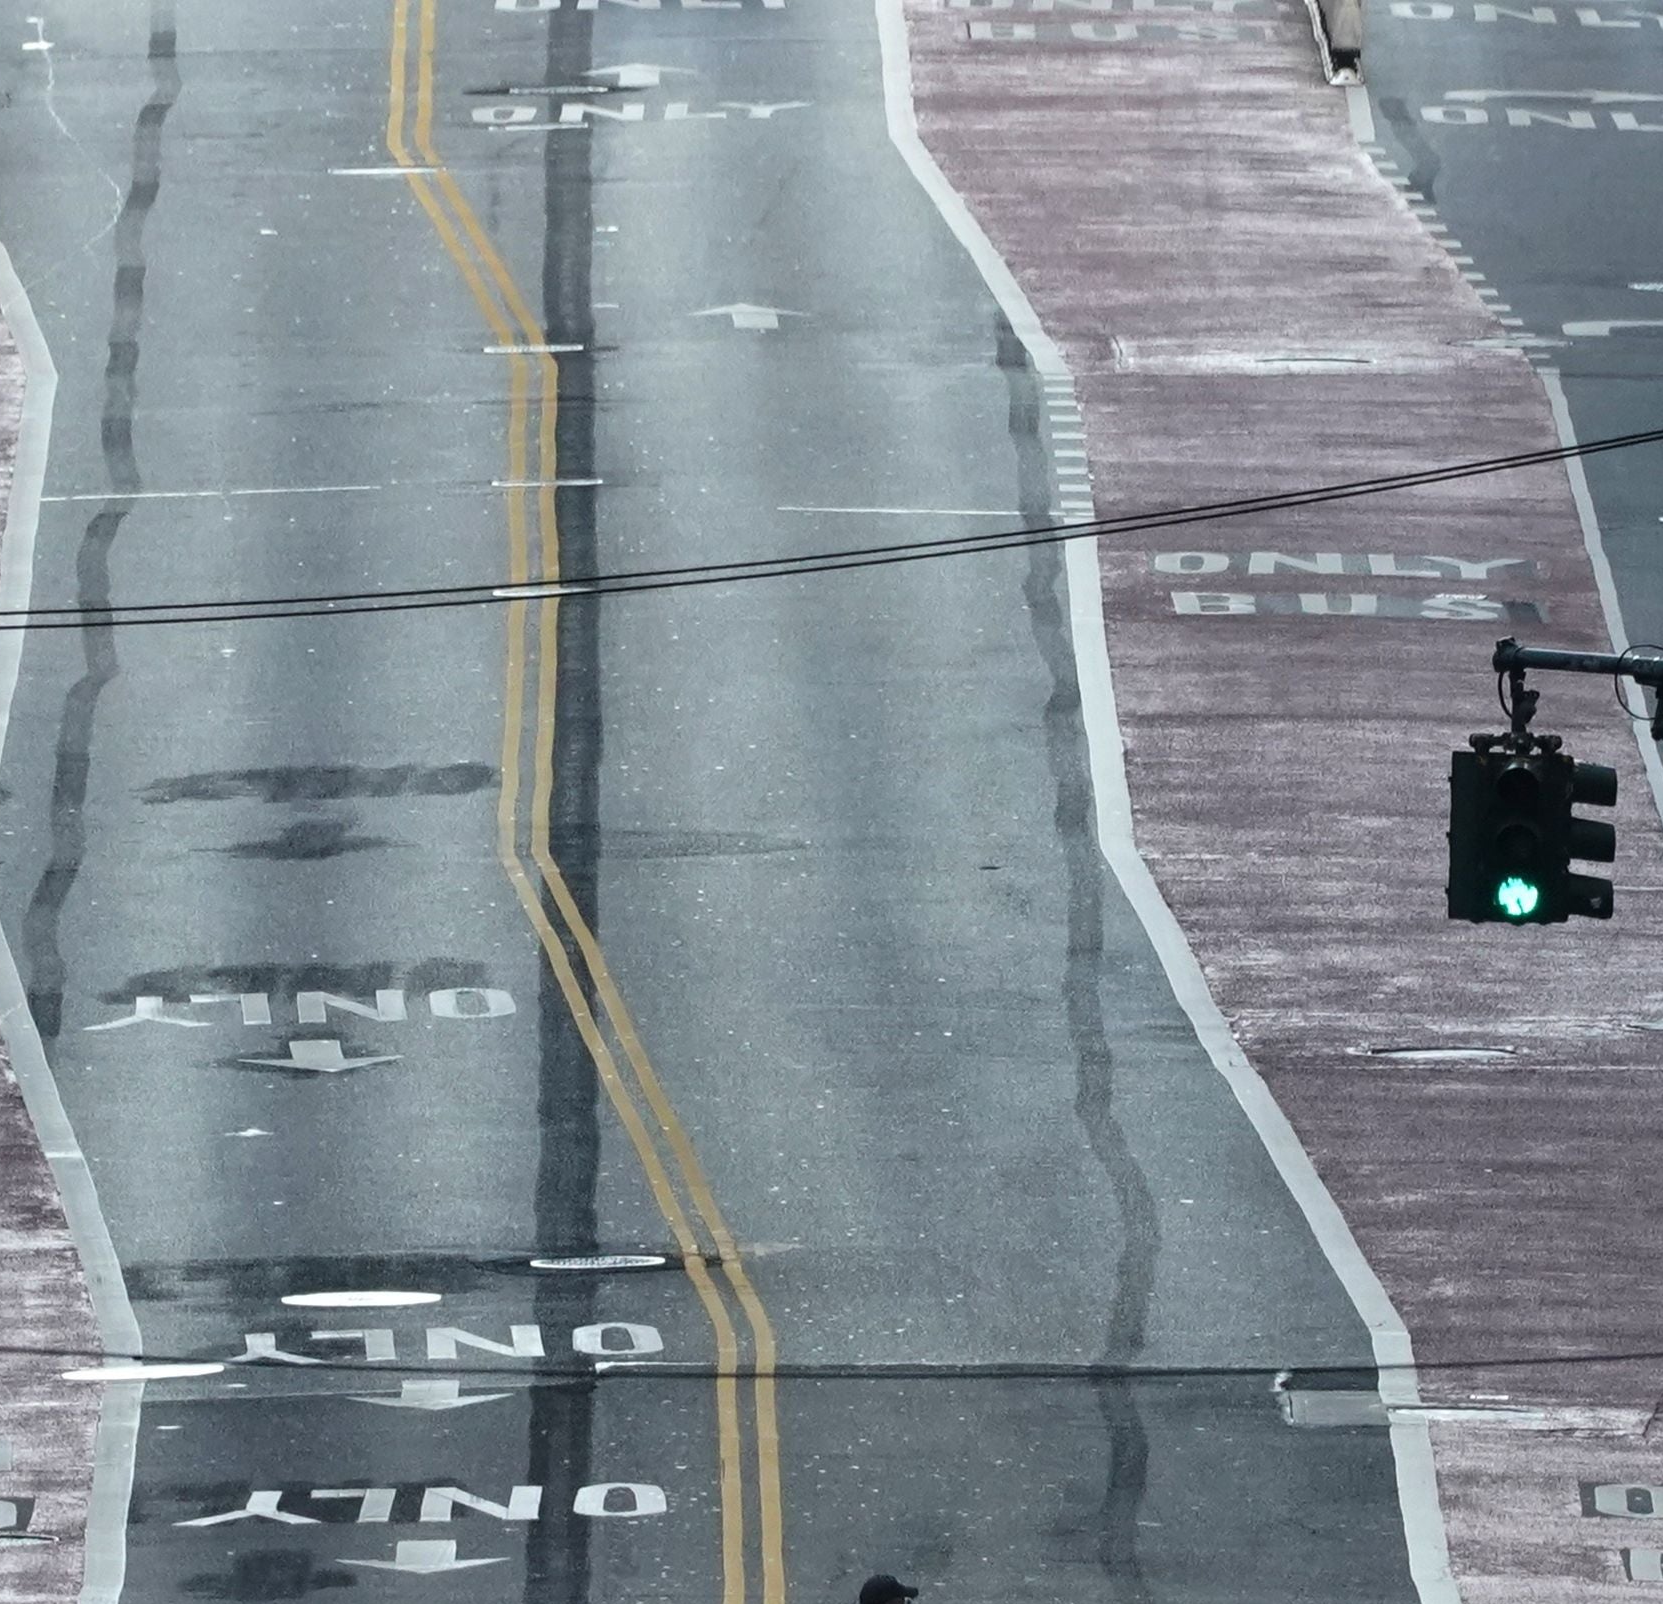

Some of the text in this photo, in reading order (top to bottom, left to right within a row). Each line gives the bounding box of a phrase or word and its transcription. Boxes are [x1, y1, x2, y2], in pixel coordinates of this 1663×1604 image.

[471, 102, 814, 123] ONLY
[1154, 551, 1526, 580] ONLY
[1173, 591, 1503, 619] BUS
[85, 987, 517, 1031] ONLY
[227, 1322, 663, 1365] ONLY
[174, 1482, 668, 1528] ONLY
